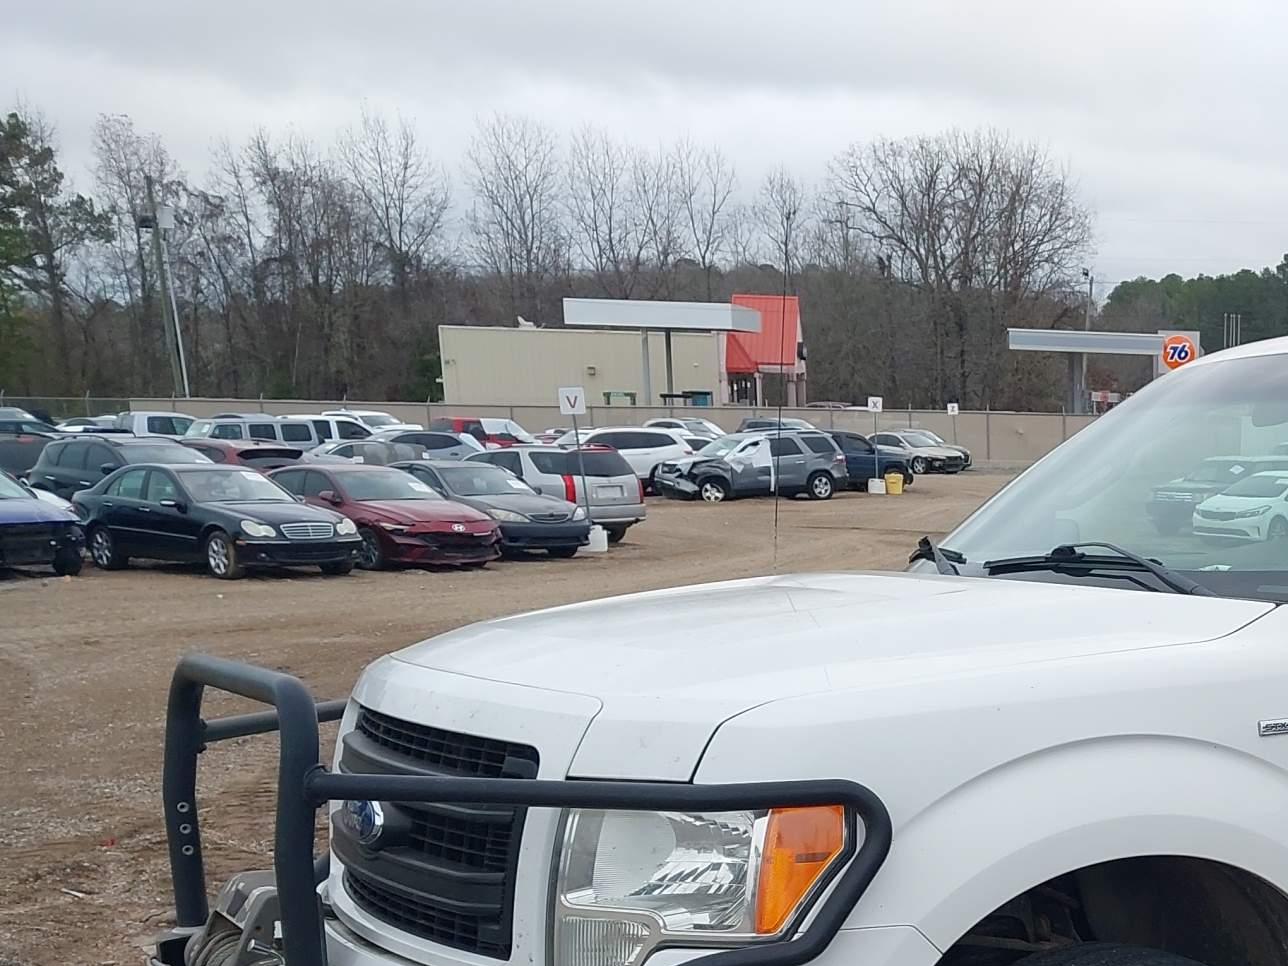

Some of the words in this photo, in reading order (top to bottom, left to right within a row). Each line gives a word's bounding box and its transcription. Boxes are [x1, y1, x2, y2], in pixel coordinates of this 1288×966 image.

[1166, 343, 1190, 363] 76
[565, 395, 578, 409] V
[871, 400, 879, 409] X
